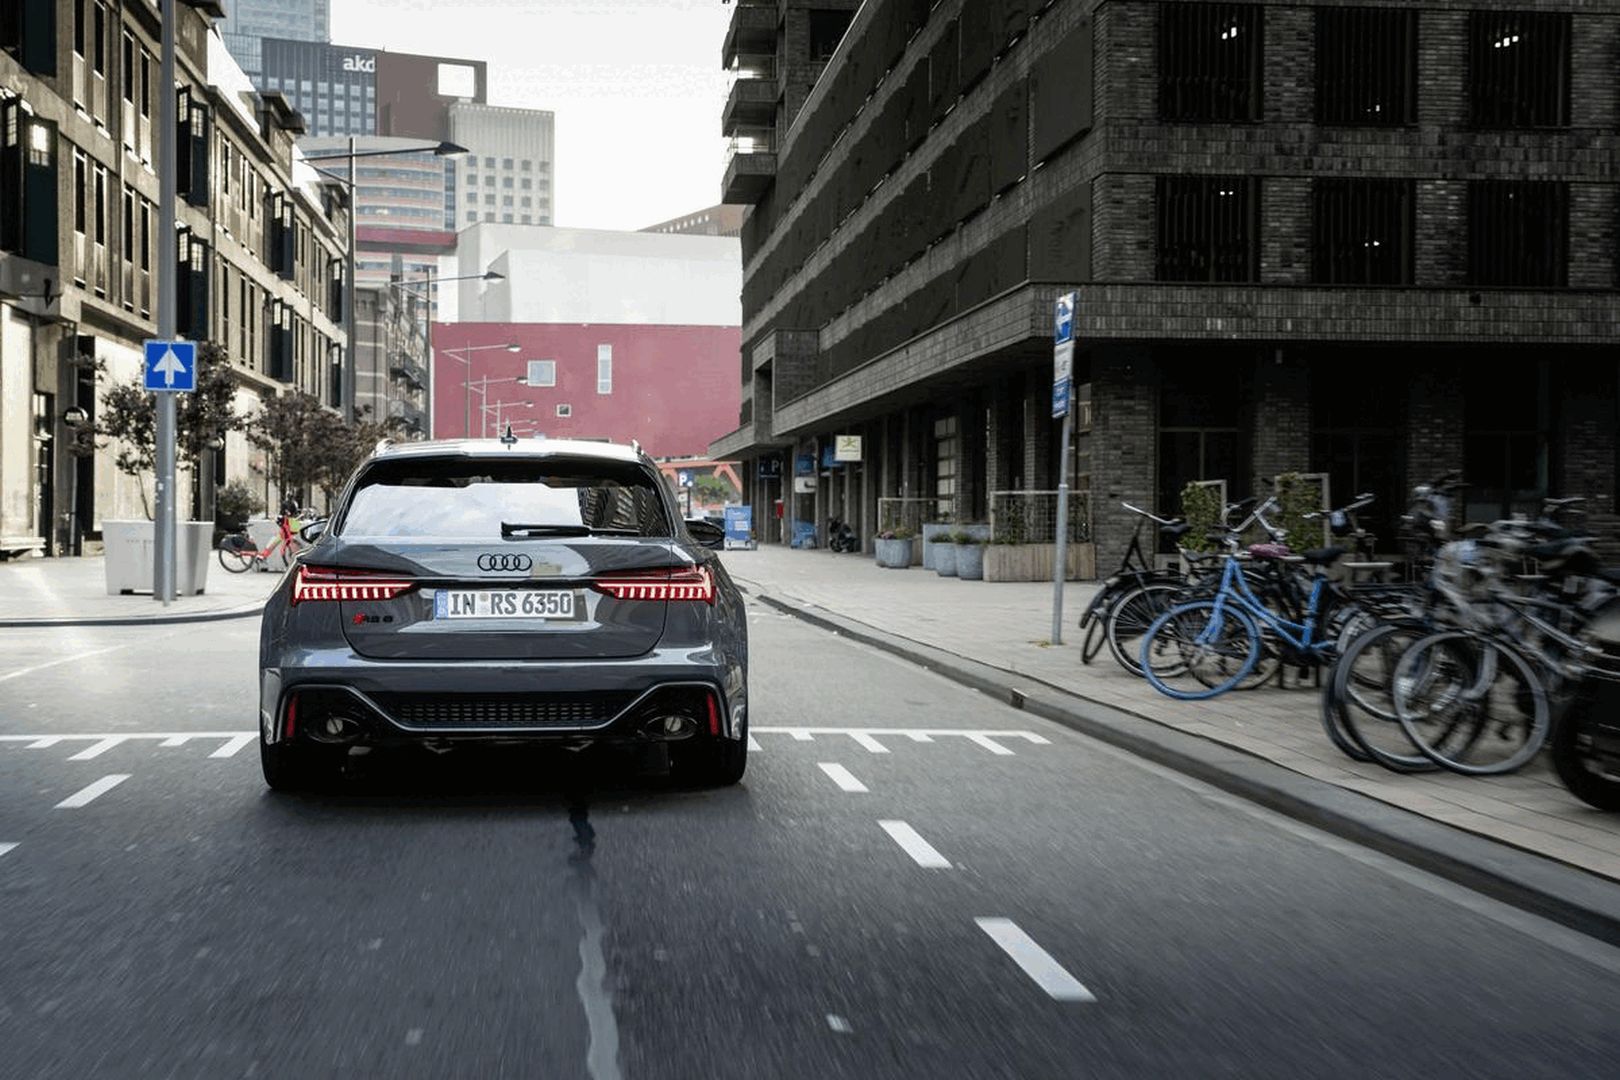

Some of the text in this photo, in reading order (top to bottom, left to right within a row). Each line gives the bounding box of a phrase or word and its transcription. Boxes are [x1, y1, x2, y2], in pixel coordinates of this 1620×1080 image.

[343, 55, 375, 73] akd
[450, 593, 477, 615] IN
[490, 593, 518, 615] RS
[521, 592, 572, 615] 6350
